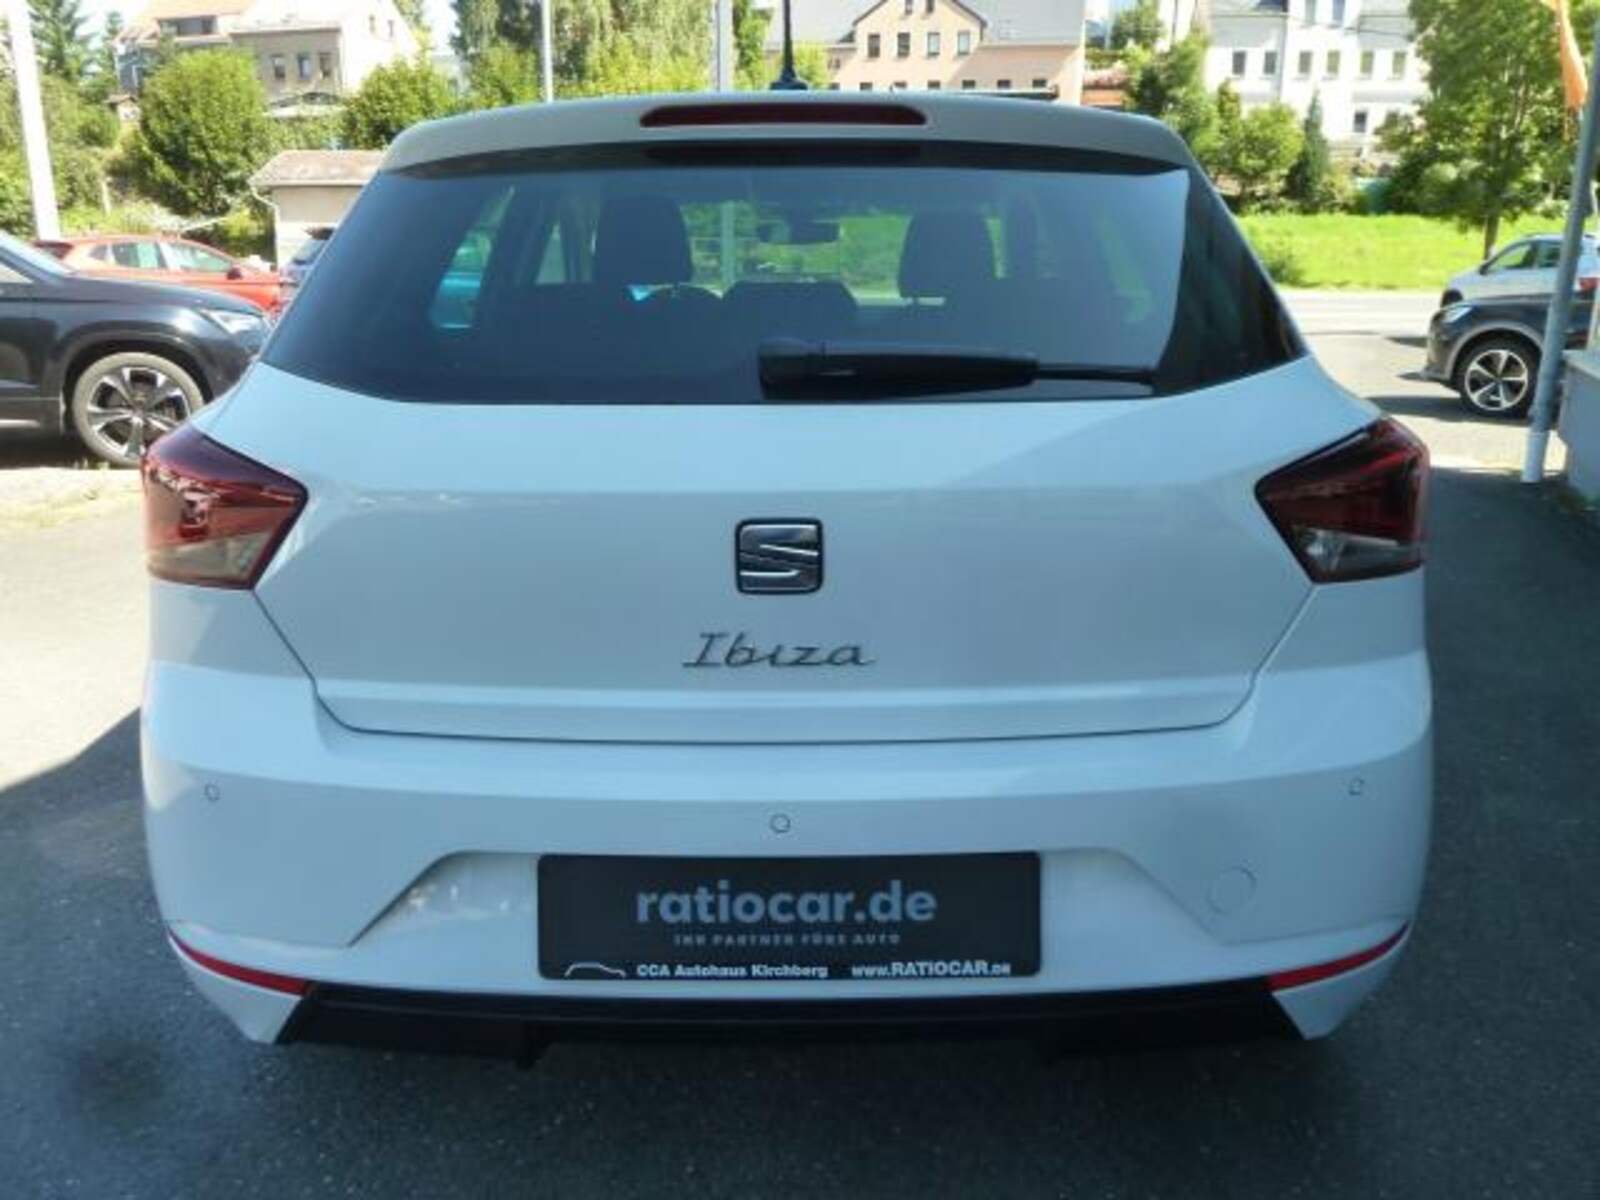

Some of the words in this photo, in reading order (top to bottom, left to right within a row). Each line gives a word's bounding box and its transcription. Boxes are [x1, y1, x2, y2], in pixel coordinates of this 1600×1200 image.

[682, 632, 877, 668] Ibiza
[636, 879, 938, 924] ratiocar.de
[674, 934, 706, 946] IHR
[713, 934, 794, 946] PARTNER
[852, 933, 901, 945] AUTO
[636, 964, 671, 977] CCA
[674, 964, 748, 977] Autohaus
[752, 964, 829, 979] Kirchberg
